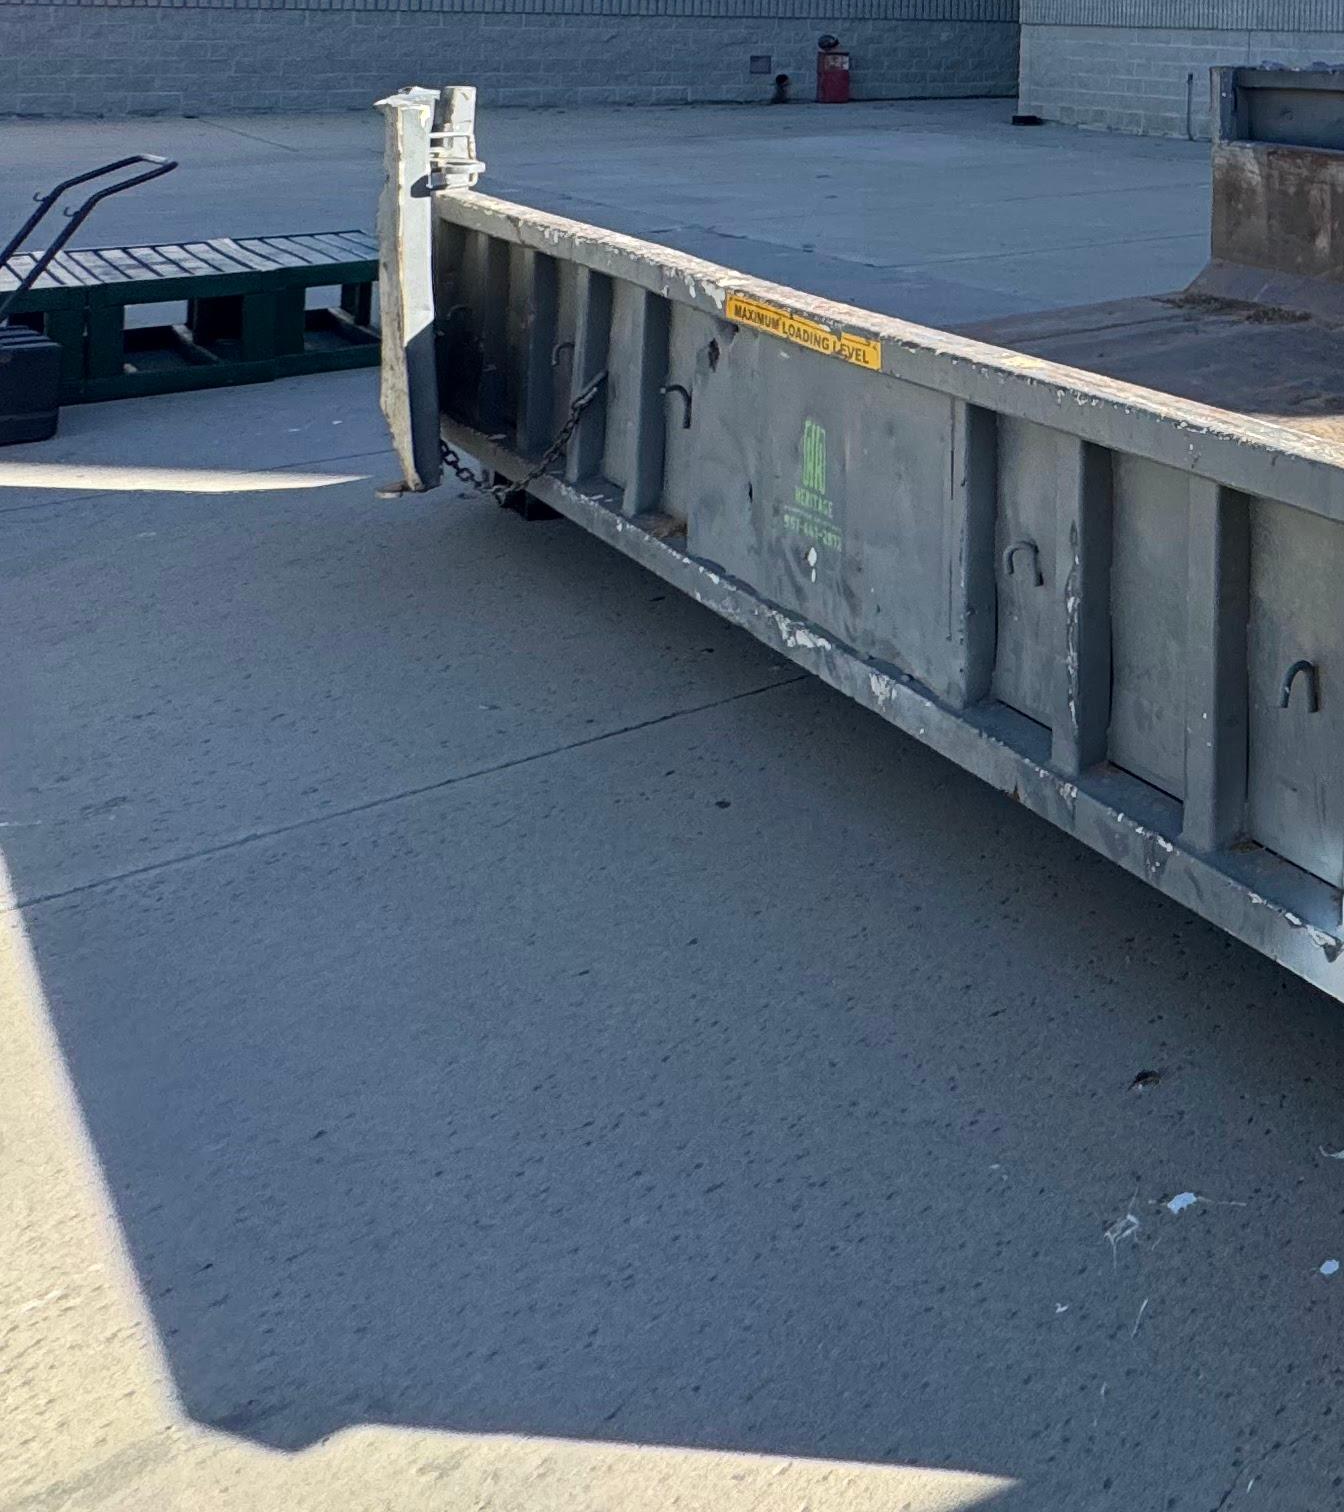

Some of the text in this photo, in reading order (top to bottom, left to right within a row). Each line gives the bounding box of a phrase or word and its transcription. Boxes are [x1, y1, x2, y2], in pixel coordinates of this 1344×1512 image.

[734, 303, 870, 364] MAXIMUM LOADING LEVEL
